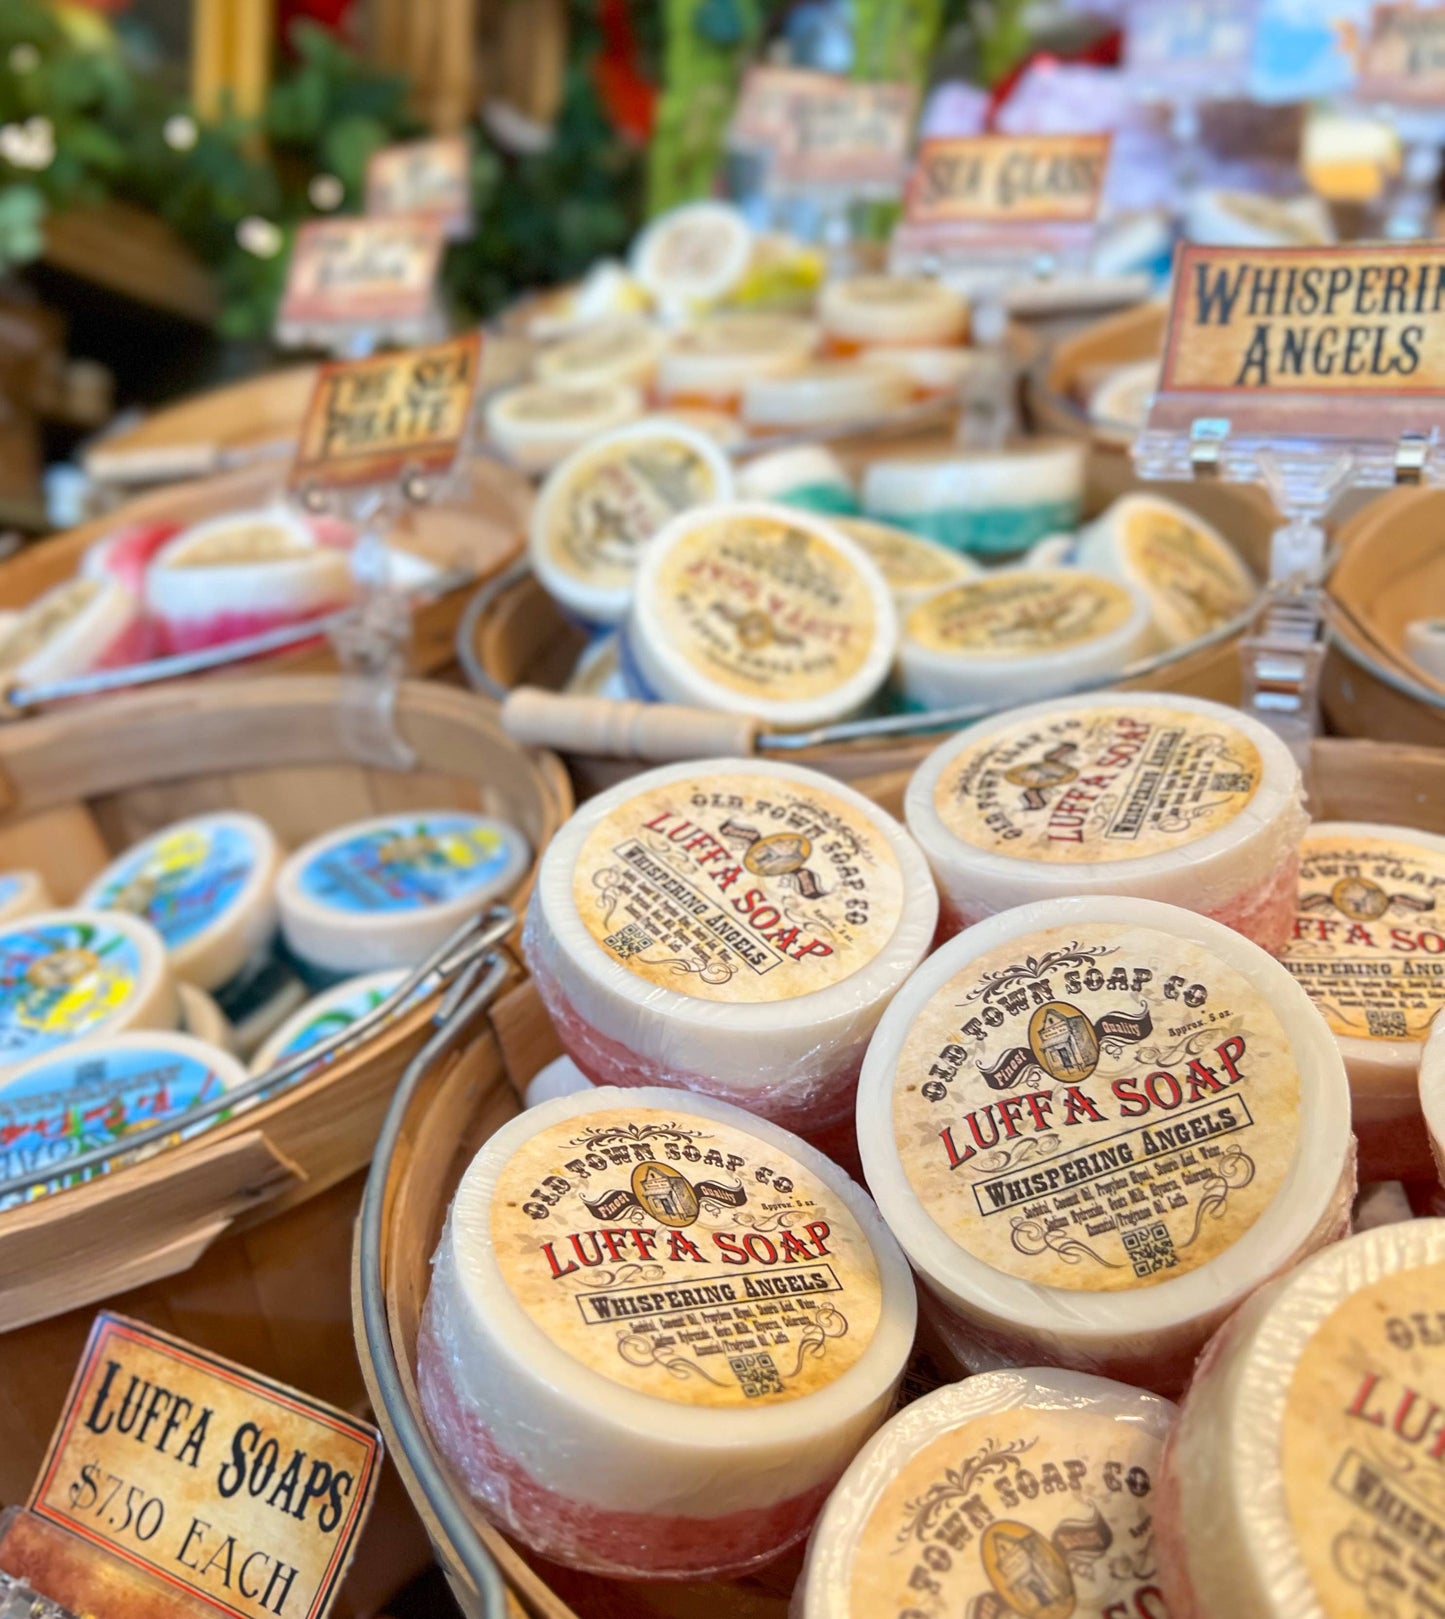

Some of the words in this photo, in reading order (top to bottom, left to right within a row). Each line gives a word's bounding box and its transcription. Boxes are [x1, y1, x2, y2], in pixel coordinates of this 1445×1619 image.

[1233, 323, 1424, 386] ANGELS
[623, 845, 709, 915] WHISPERING
[705, 913, 769, 967] ANGELS
[641, 811, 746, 894] LUFFA
[730, 887, 834, 961] SOAP
[1292, 917, 1379, 949] FFA
[1390, 927, 1445, 954] SO
[1284, 961, 1392, 976] HISPERING
[1403, 960, 1445, 976] ANG
[921, 1044, 968, 1102] OLD
[960, 978, 1056, 1041] TOWN
[1064, 967, 1153, 995] SOAP
[995, 1049, 1028, 1087] Finest
[1101, 1020, 1141, 1037] Quality
[938, 1086, 1108, 1171] LUFFA
[1110, 1035, 1248, 1118] SOAP
[522, 1175, 573, 1221] OLD
[564, 1142, 655, 1173] TOWN
[665, 1142, 746, 1173] SOAP
[983, 1142, 1134, 1209] WHISPERING
[1142, 1107, 1238, 1154] ANGELS
[540, 1228, 709, 1281] LUFFA
[712, 1220, 832, 1266] SOAP
[588, 1282, 736, 1320] WHISPERING
[743, 1270, 829, 1298] ANGELS
[84, 1360, 214, 1468] LUFFA
[217, 1421, 355, 1534] SOAPS
[67, 1460, 165, 1541] $7.50
[175, 1516, 299, 1616] EACH
[907, 1493, 995, 1596] TOWN
[993, 1458, 1087, 1510] SOAP
